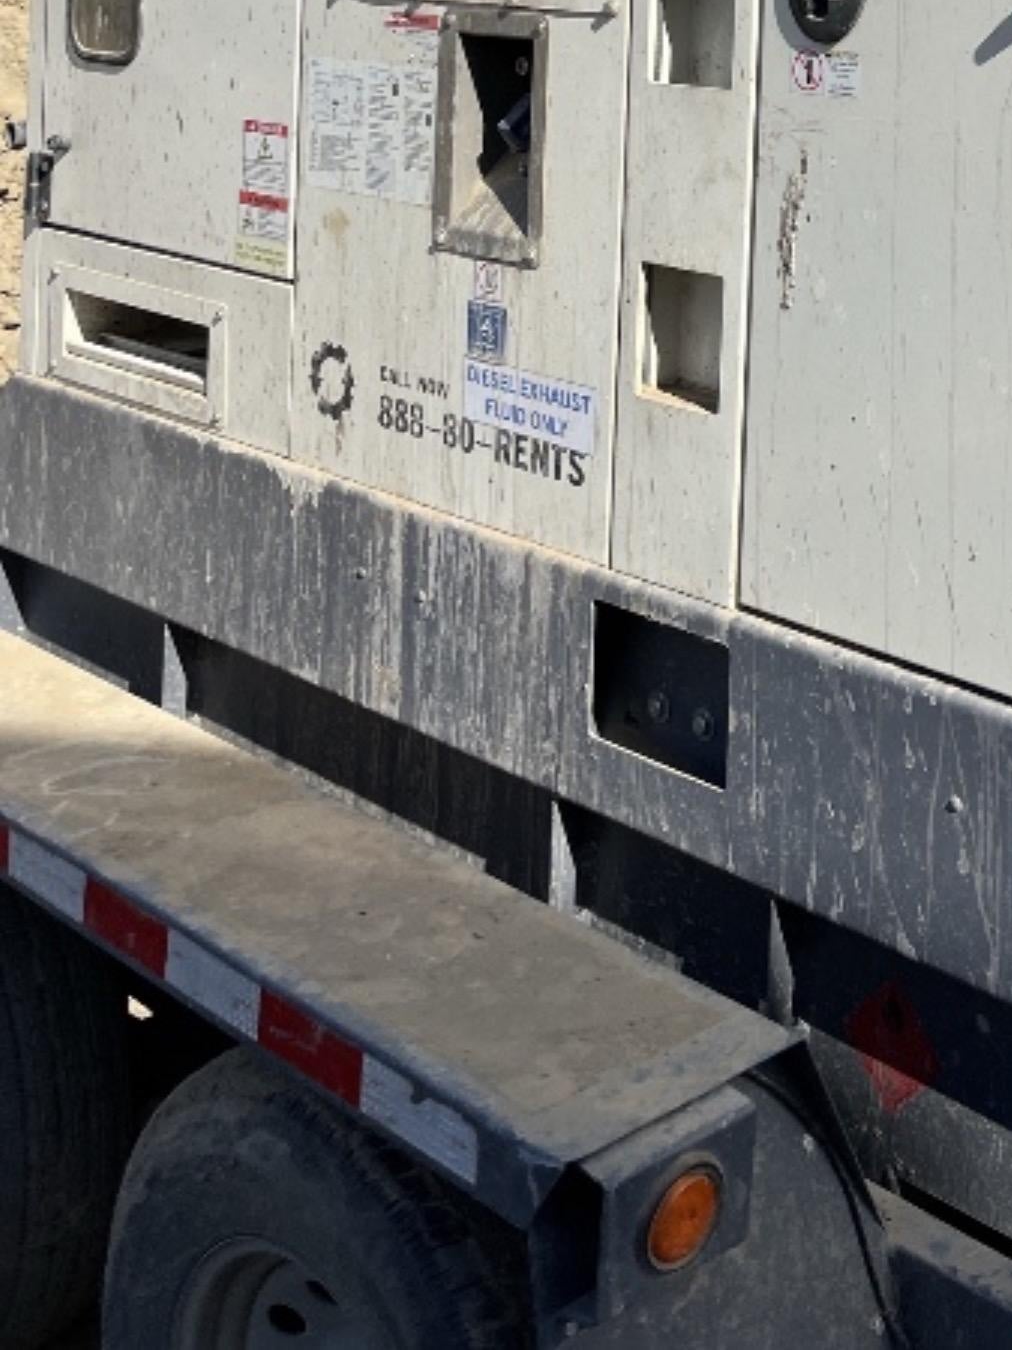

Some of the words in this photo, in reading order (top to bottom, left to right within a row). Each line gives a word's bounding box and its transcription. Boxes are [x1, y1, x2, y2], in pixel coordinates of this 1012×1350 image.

[467, 364, 516, 393] DIESEL
[520, 378, 592, 415] EXHAUST
[377, 395, 585, 487] 888-80-RENTS
[485, 398, 526, 426] FLUID
[530, 410, 569, 438] ONLY
